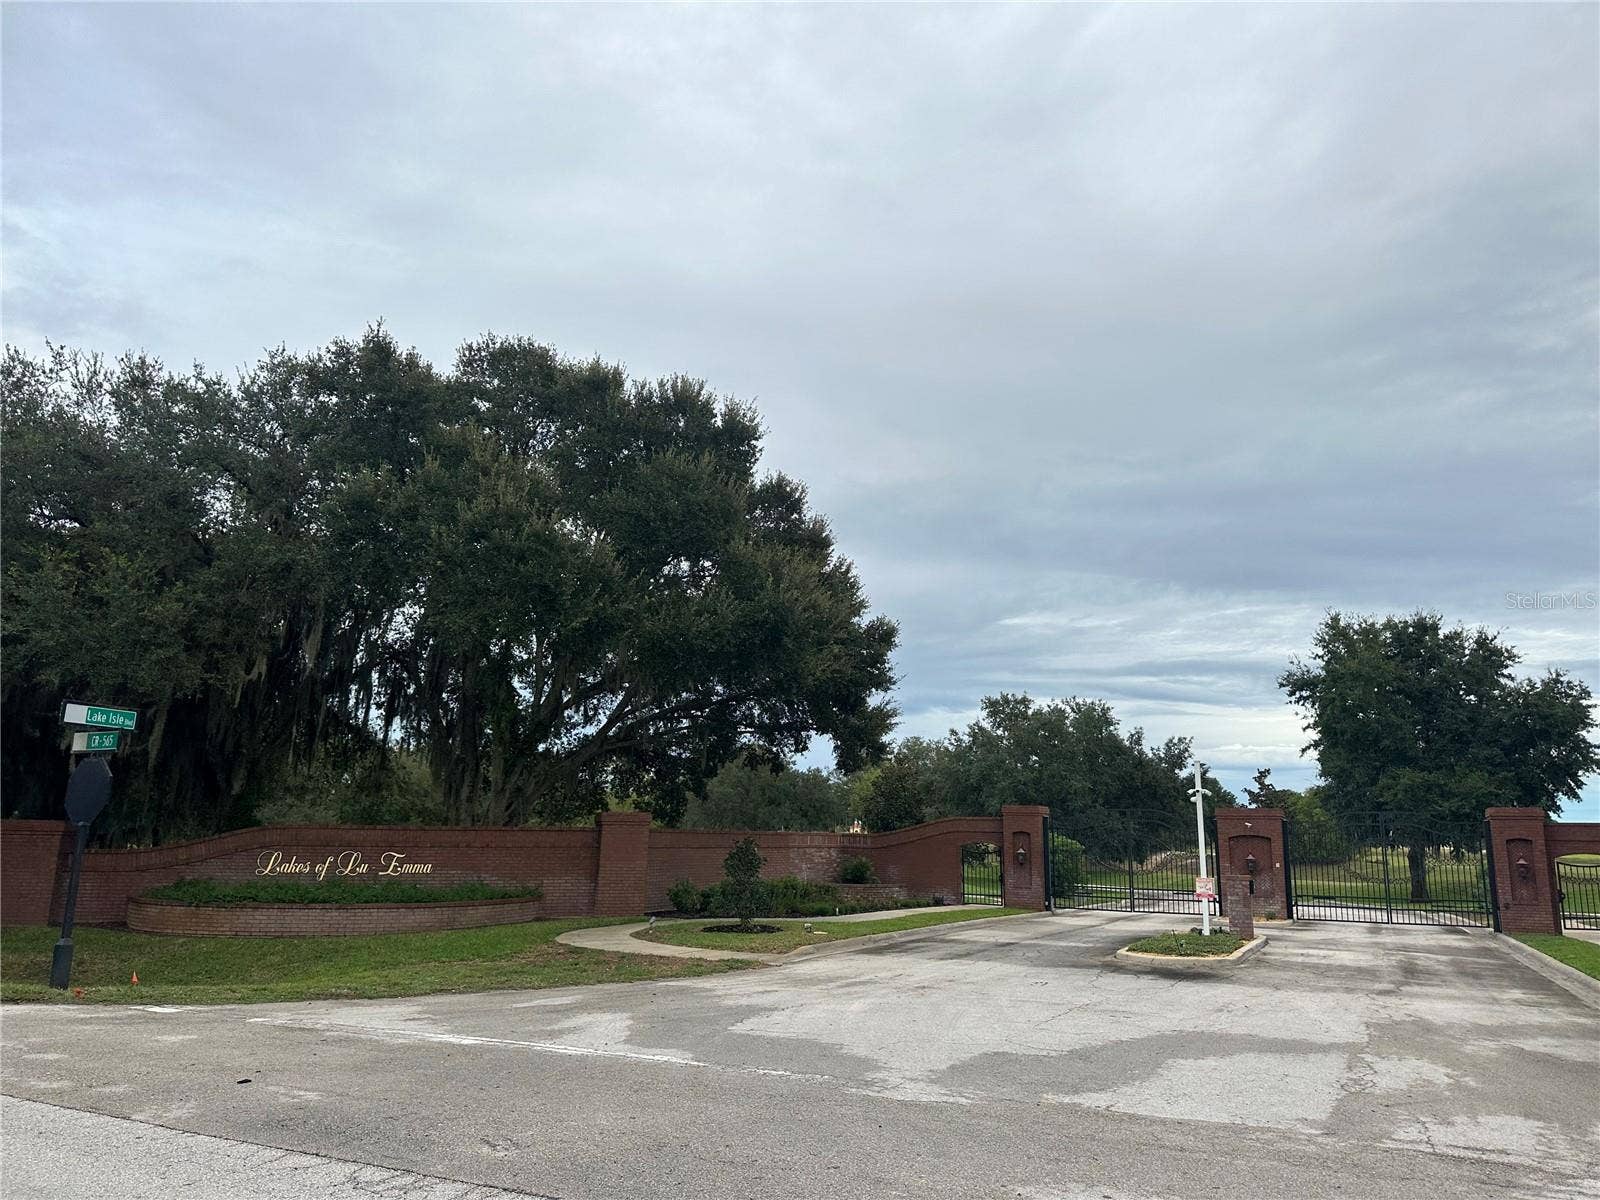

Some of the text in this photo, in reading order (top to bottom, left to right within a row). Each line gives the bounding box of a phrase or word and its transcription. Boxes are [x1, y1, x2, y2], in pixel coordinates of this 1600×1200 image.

[87, 710, 107, 723] Lake
[108, 712, 124, 725] Isle
[91, 735, 114, 747] CR-565
[255, 850, 311, 876] Lakes
[315, 855, 335, 881] of
